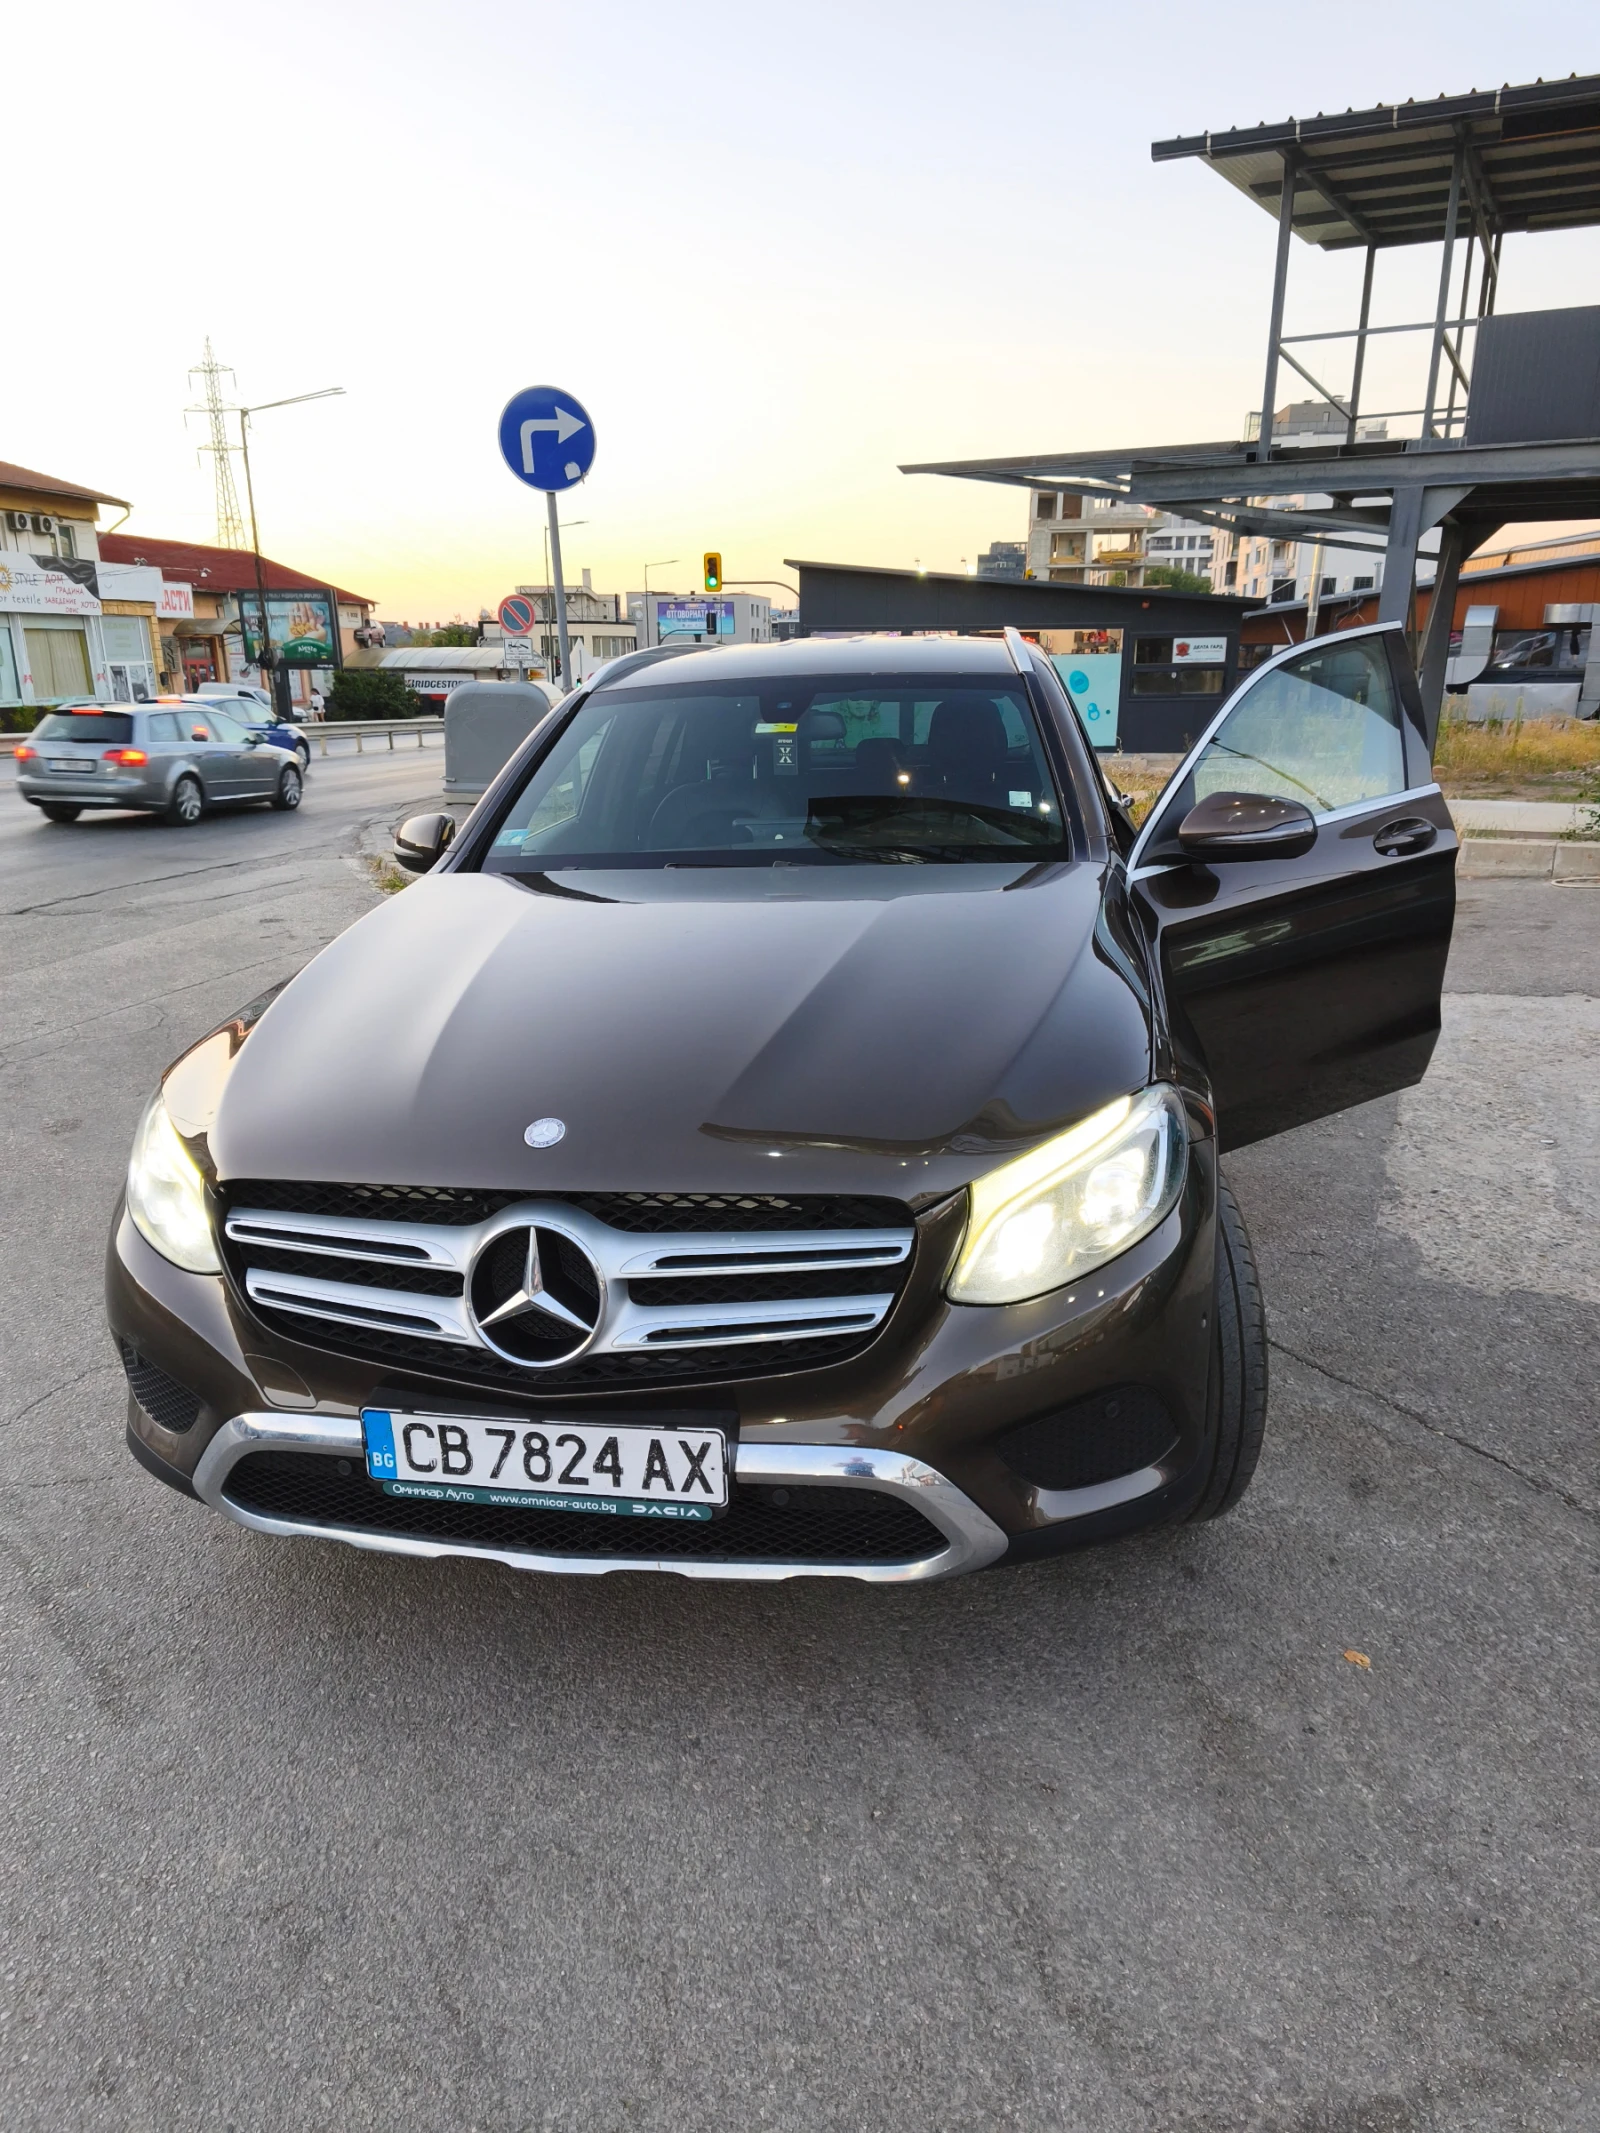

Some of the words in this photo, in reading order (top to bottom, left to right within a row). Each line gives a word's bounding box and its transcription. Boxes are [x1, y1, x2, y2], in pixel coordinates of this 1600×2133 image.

[45, 574, 64, 585] ДОМ
[56, 586, 84, 595] ГРАДИНА
[12, 593, 41, 604] textile
[81, 601, 100, 609] ХОТЕЛ
[372, 1451, 394, 1468] BG
[402, 1422, 474, 1476] CB
[484, 1427, 624, 1488] 7824
[641, 1438, 714, 1495] AX
[392, 1483, 444, 1499] Омникар
[446, 1488, 475, 1501] Ауто
[489, 1493, 617, 1514] www.omnicar-auto.bg
[632, 1504, 702, 1518] DACIA
